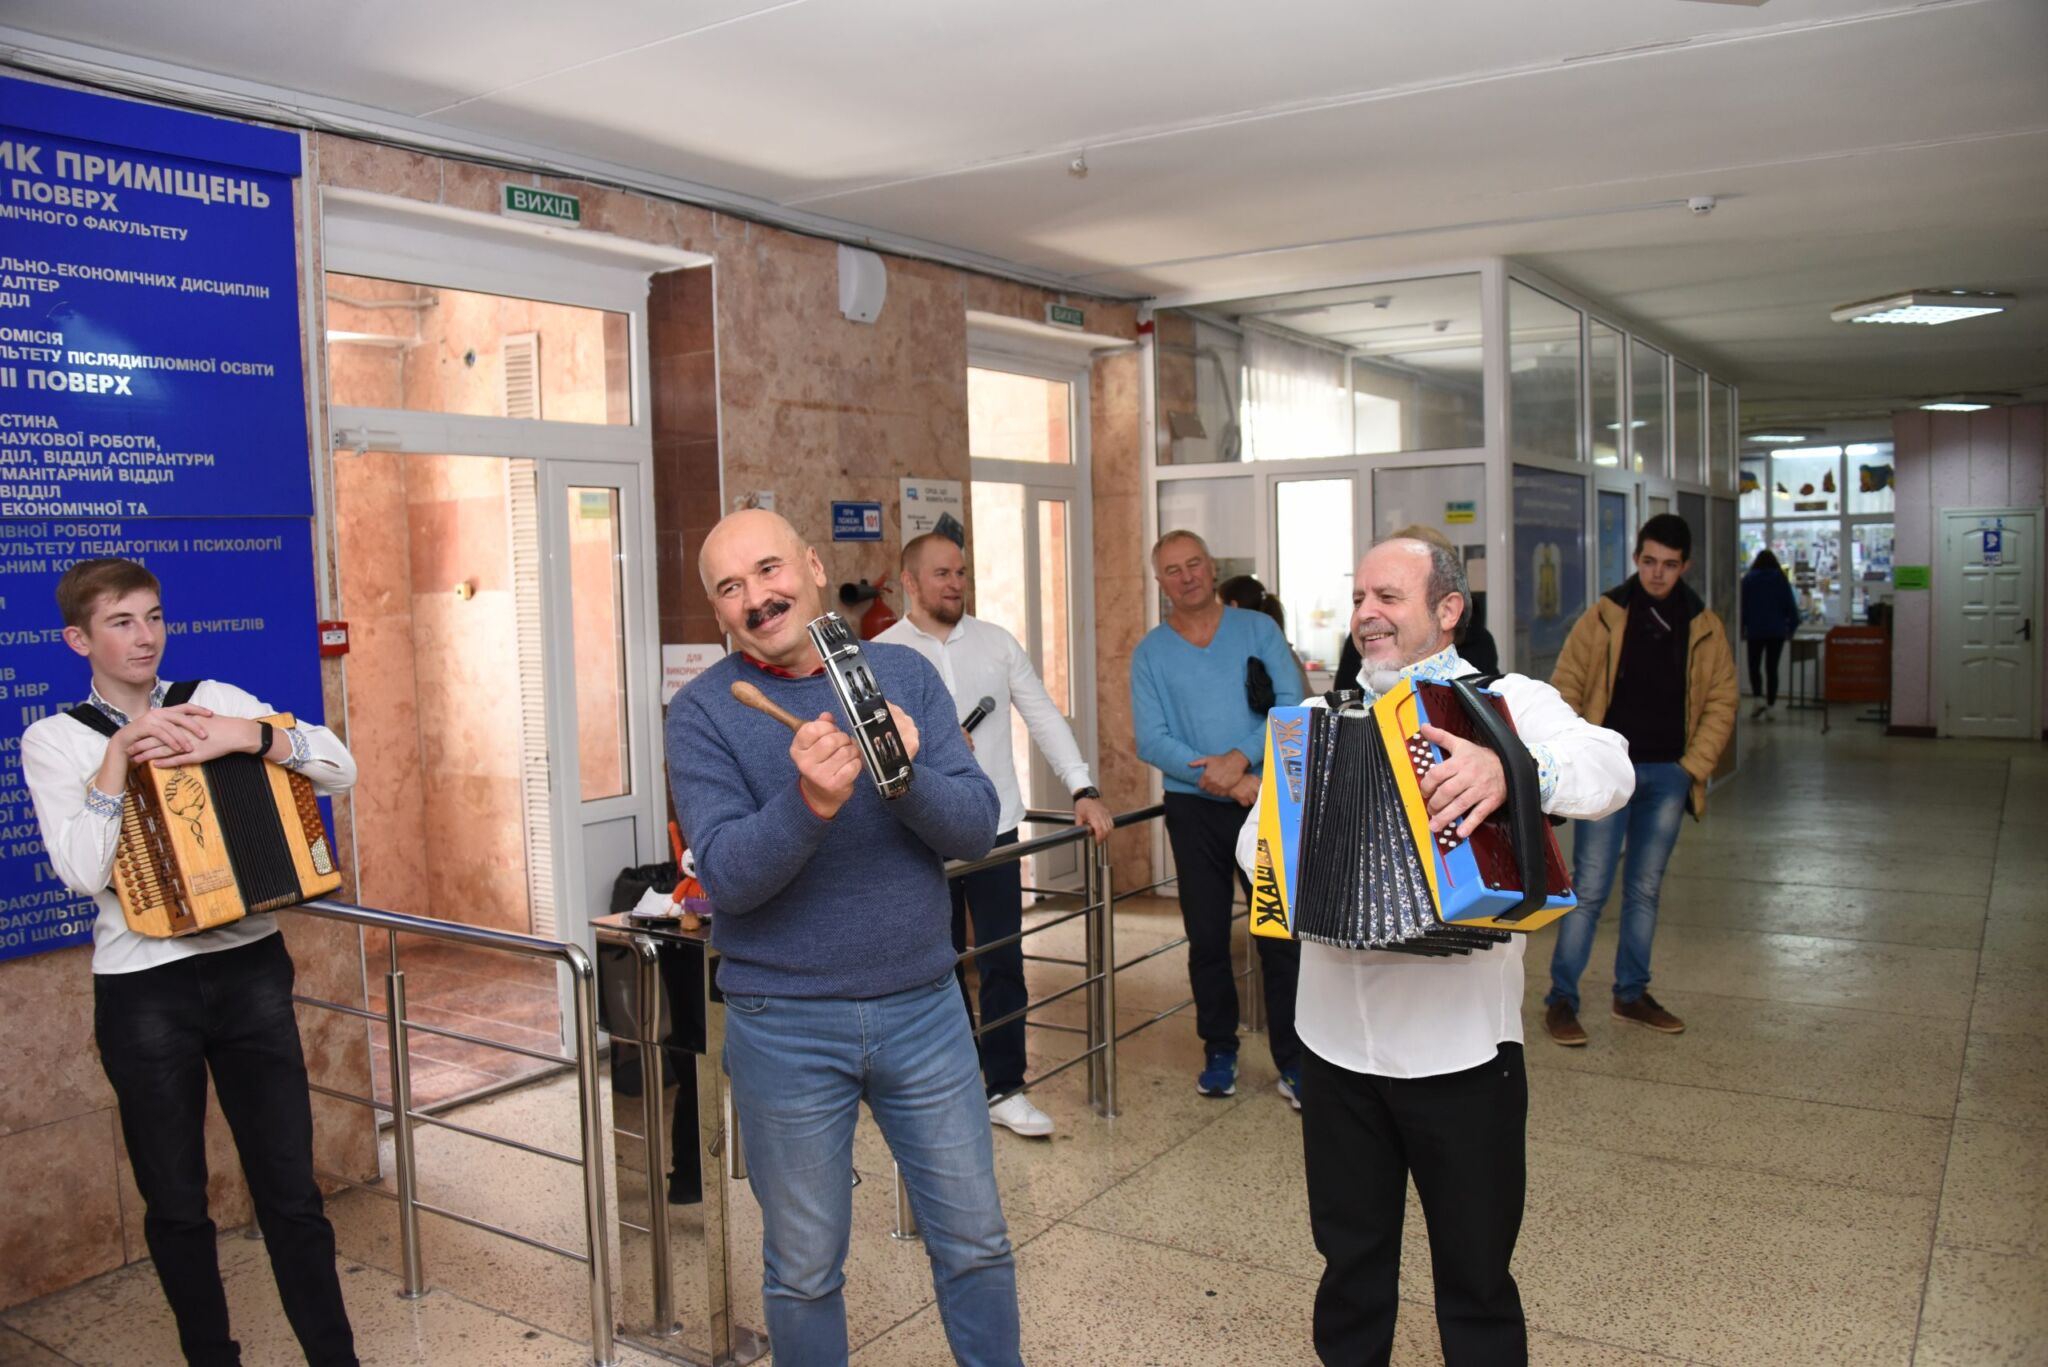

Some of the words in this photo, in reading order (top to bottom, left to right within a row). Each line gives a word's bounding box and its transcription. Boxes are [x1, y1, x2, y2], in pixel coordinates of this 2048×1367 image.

[56, 150, 271, 208] ПРИМІЩЕНЬ
[12, 178, 119, 213] ПОВЕРХ
[513, 190, 574, 218] ВИХІД
[0, 203, 78, 228] МІЧНОГО
[83, 215, 188, 241] ФАКУЛЬТЕТУ
[0, 257, 177, 289] ЛЬНО-ЕКОНОМІЧНИХ
[181, 276, 270, 299] ДИСЦИПЛІН
[0, 274, 60, 293] АЛТЕР
[0, 327, 63, 346] ОМІСІЯ
[67, 350, 216, 373] ПІСЛЯДИПЛОМНОЇ
[221, 361, 275, 376] ОСВІТИ
[27, 368, 133, 396] ПОВЕРХ
[0, 413, 59, 430] СТИНА
[89, 434, 161, 450] РОБОТИ,
[43, 450, 103, 467] ВІДДІЛ
[108, 451, 215, 467] АСПІРАНТУРИ
[0, 466, 114, 482] МАНІТАРНИЙ
[118, 469, 175, 483] ВІДДІЛ
[0, 485, 61, 500] ВІДДІЛ
[2, 500, 123, 516] ЕКОНОМІЧНОЇ
[127, 502, 149, 516] ТА
[54, 523, 122, 537] РОБОТИ
[81, 539, 179, 556] ПЕДАГОГІКИ
[193, 536, 281, 552] ПСИХОЛОГІЇ
[192, 618, 265, 634] ВЧИТЕЛІВ
[13, 682, 50, 698] НВР
[0, 887, 86, 912] ФАКУЛЬТ
